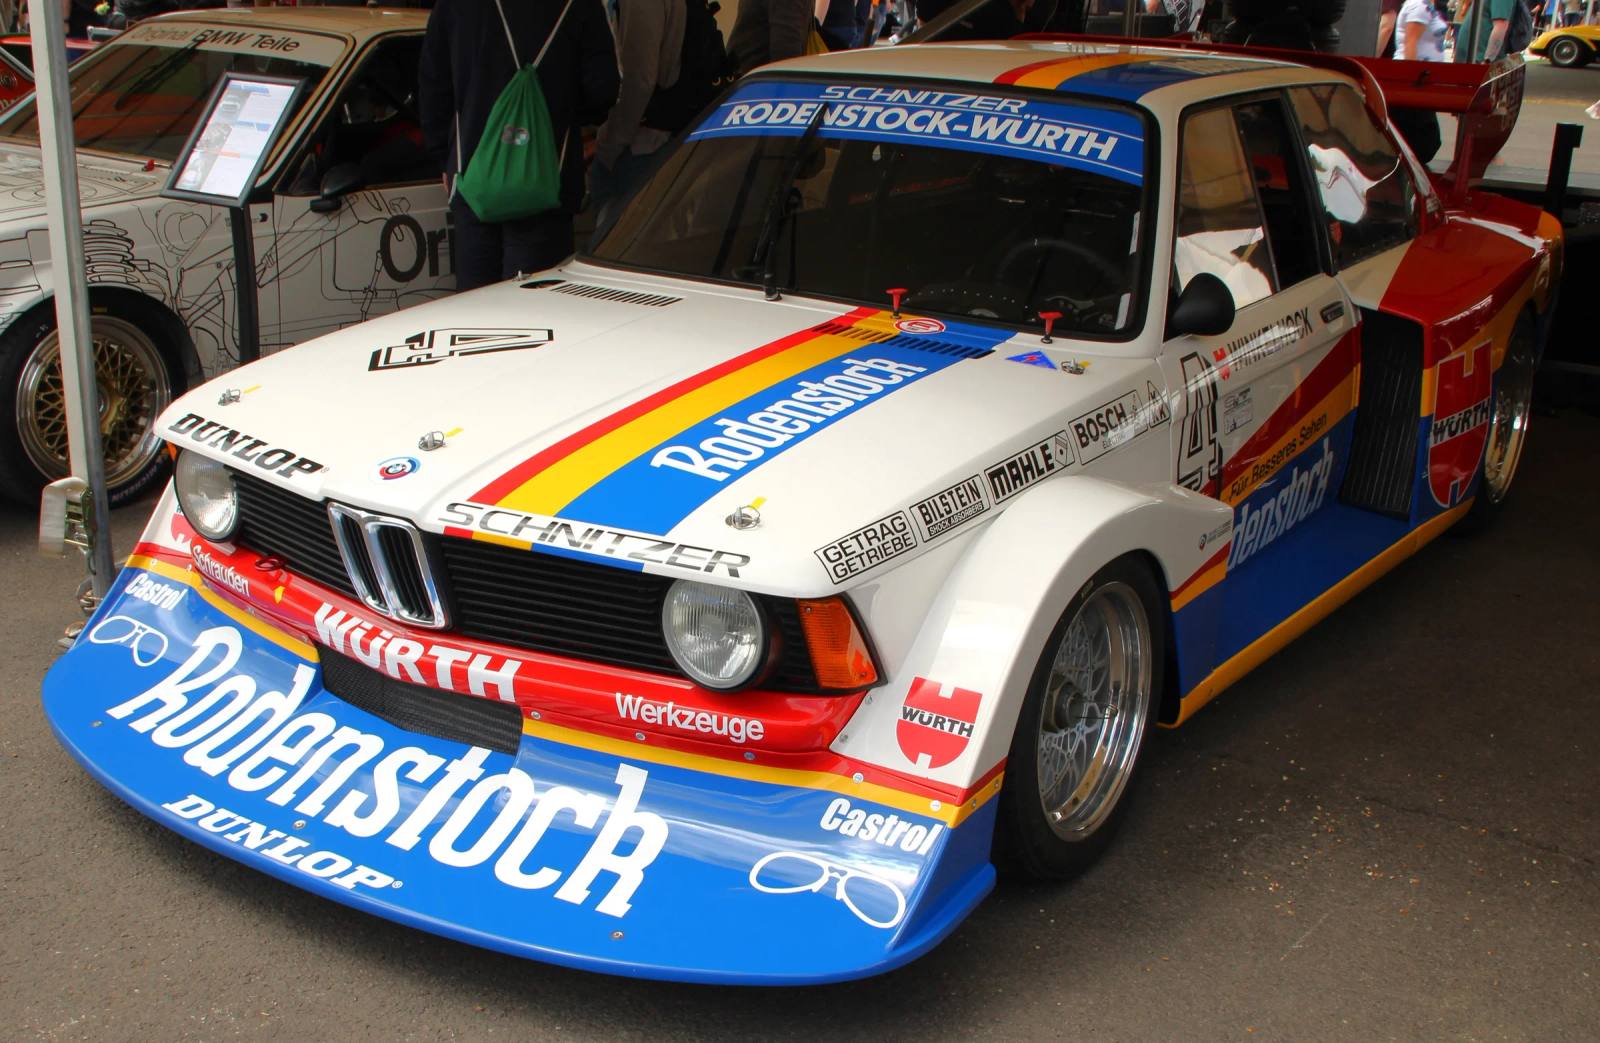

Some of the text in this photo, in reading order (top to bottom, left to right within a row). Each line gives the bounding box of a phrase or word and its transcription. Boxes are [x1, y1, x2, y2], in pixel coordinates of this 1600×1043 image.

[191, 29, 252, 45] BMW
[251, 34, 300, 52] Teile
[819, 85, 1028, 114] SCHNITZER
[723, 102, 1119, 162] RODENSTOCK-WÜRTH
[367, 327, 554, 372] 4
[651, 356, 927, 482] Rodenstock
[1074, 403, 1127, 449] BOSCH
[1177, 351, 1224, 500] 4
[1433, 397, 1490, 444] WÜRTH
[168, 412, 324, 479] DUNLOP
[988, 443, 1055, 499] MAHLE
[918, 479, 982, 526] BILSTEIN
[928, 502, 984, 537] SHOCK ABSORBERS
[437, 502, 751, 578] SCHNITZER
[823, 515, 907, 564] GETRAG
[832, 531, 913, 579] GETRIEBE
[124, 573, 188, 611] Castrol
[193, 544, 250, 598] Schrauben
[314, 601, 522, 703] WÜRTH
[615, 692, 764, 744] Werkzeuge
[902, 706, 975, 738] WÜRTH
[106, 625, 669, 918] Rodenstock
[162, 794, 392, 891] DUNLOP
[820, 797, 944, 856] Castrol
